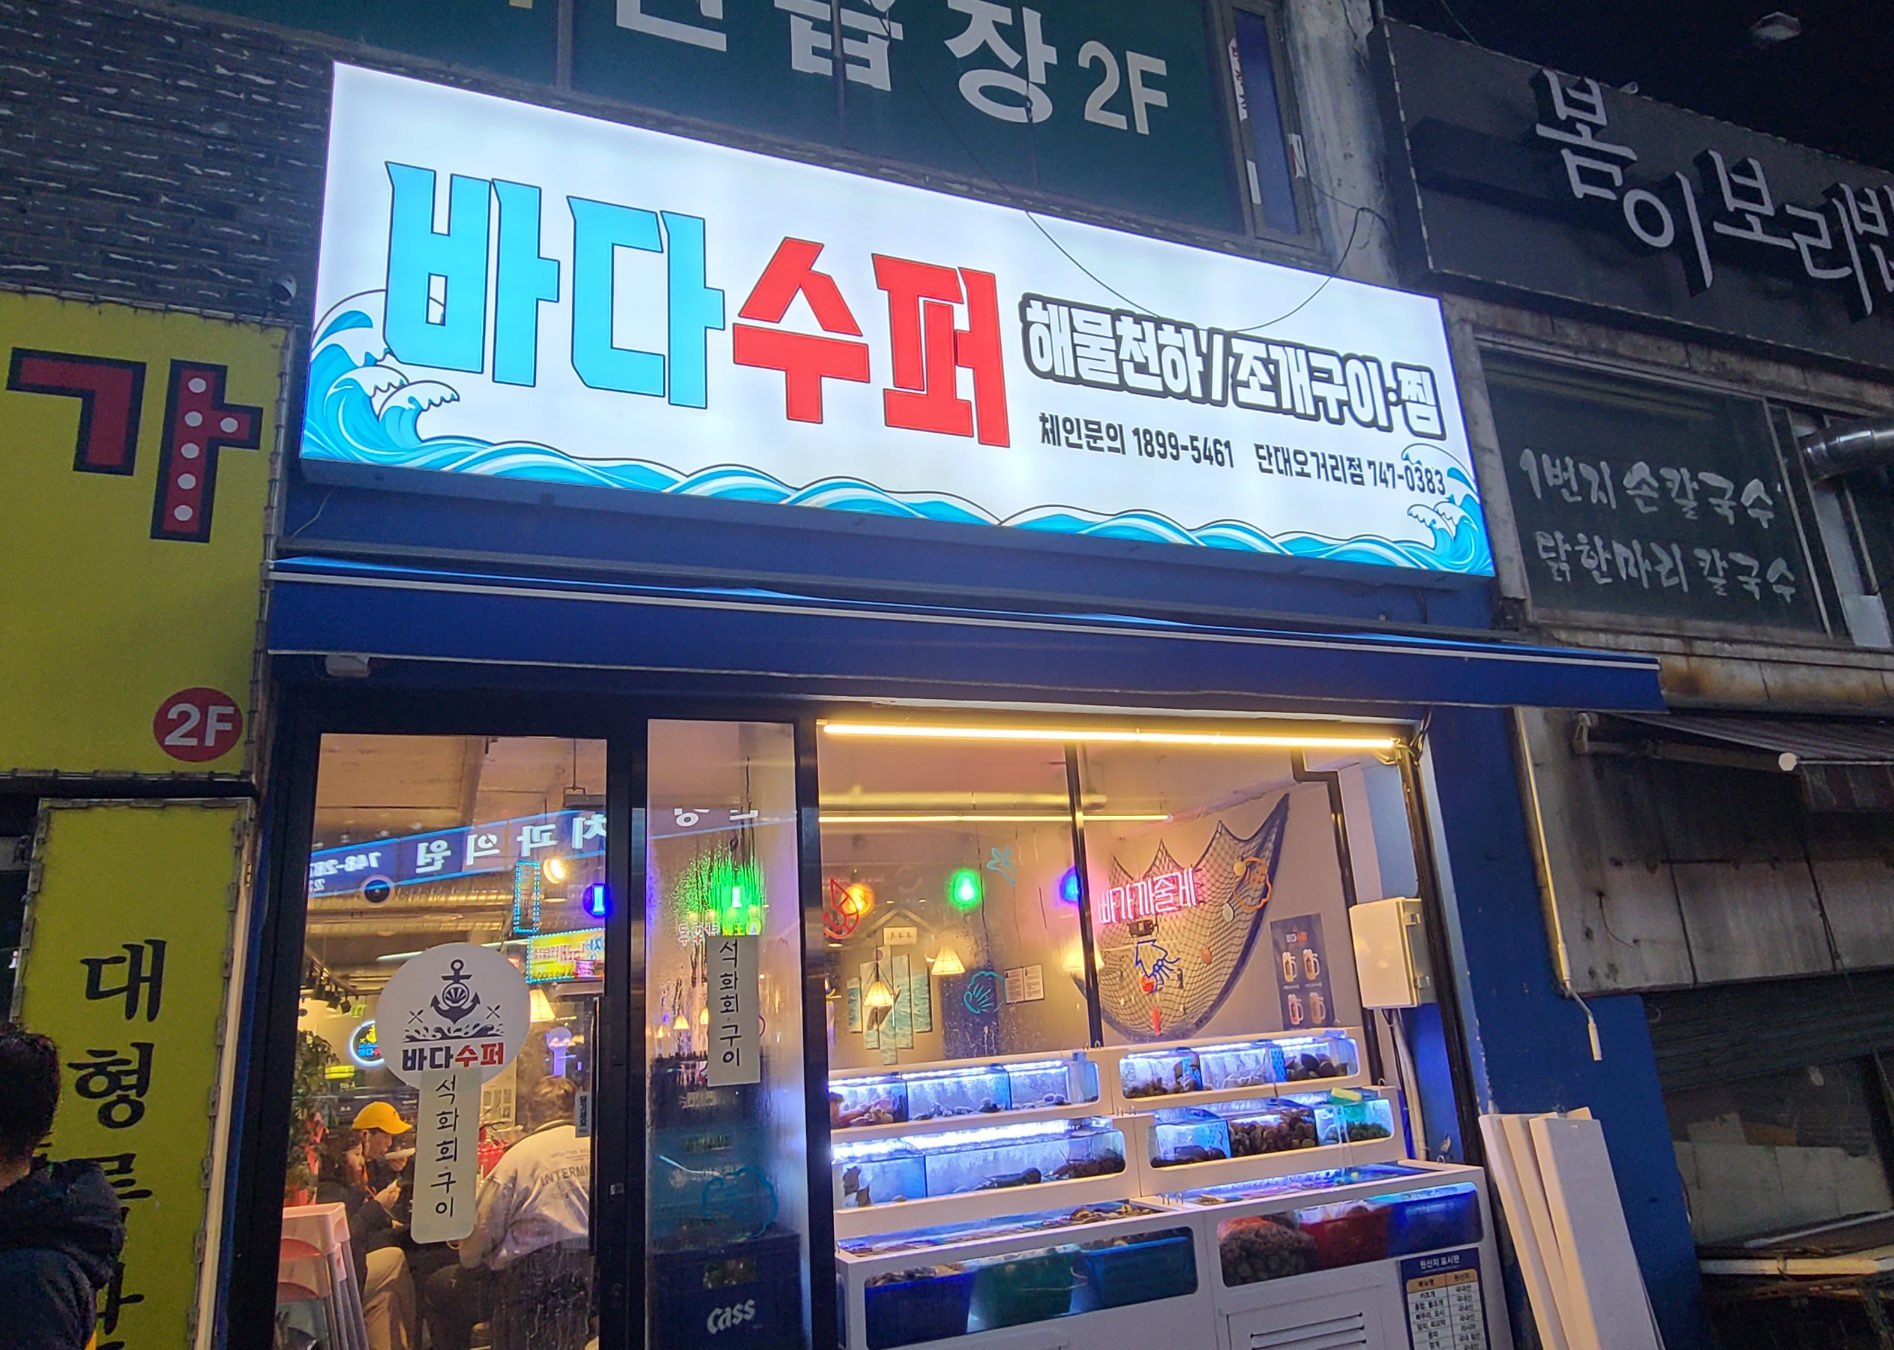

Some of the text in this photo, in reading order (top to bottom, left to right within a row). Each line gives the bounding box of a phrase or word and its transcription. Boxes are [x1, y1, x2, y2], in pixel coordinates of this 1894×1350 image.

[1078, 40, 1169, 135] 2F
[384, 161, 1010, 448] 바다수퍼
[1039, 412, 1446, 495] 체인문의 1899-5461 단대오거리점 747-0383
[1519, 448, 1775, 529] 1번지 손칼국수
[1694, 547, 1796, 603] 칼국수
[164, 702, 235, 747] 2F
[401, 1042, 504, 1071] 바다수퍼
[1420, 1257, 1439, 1270] 원산지
